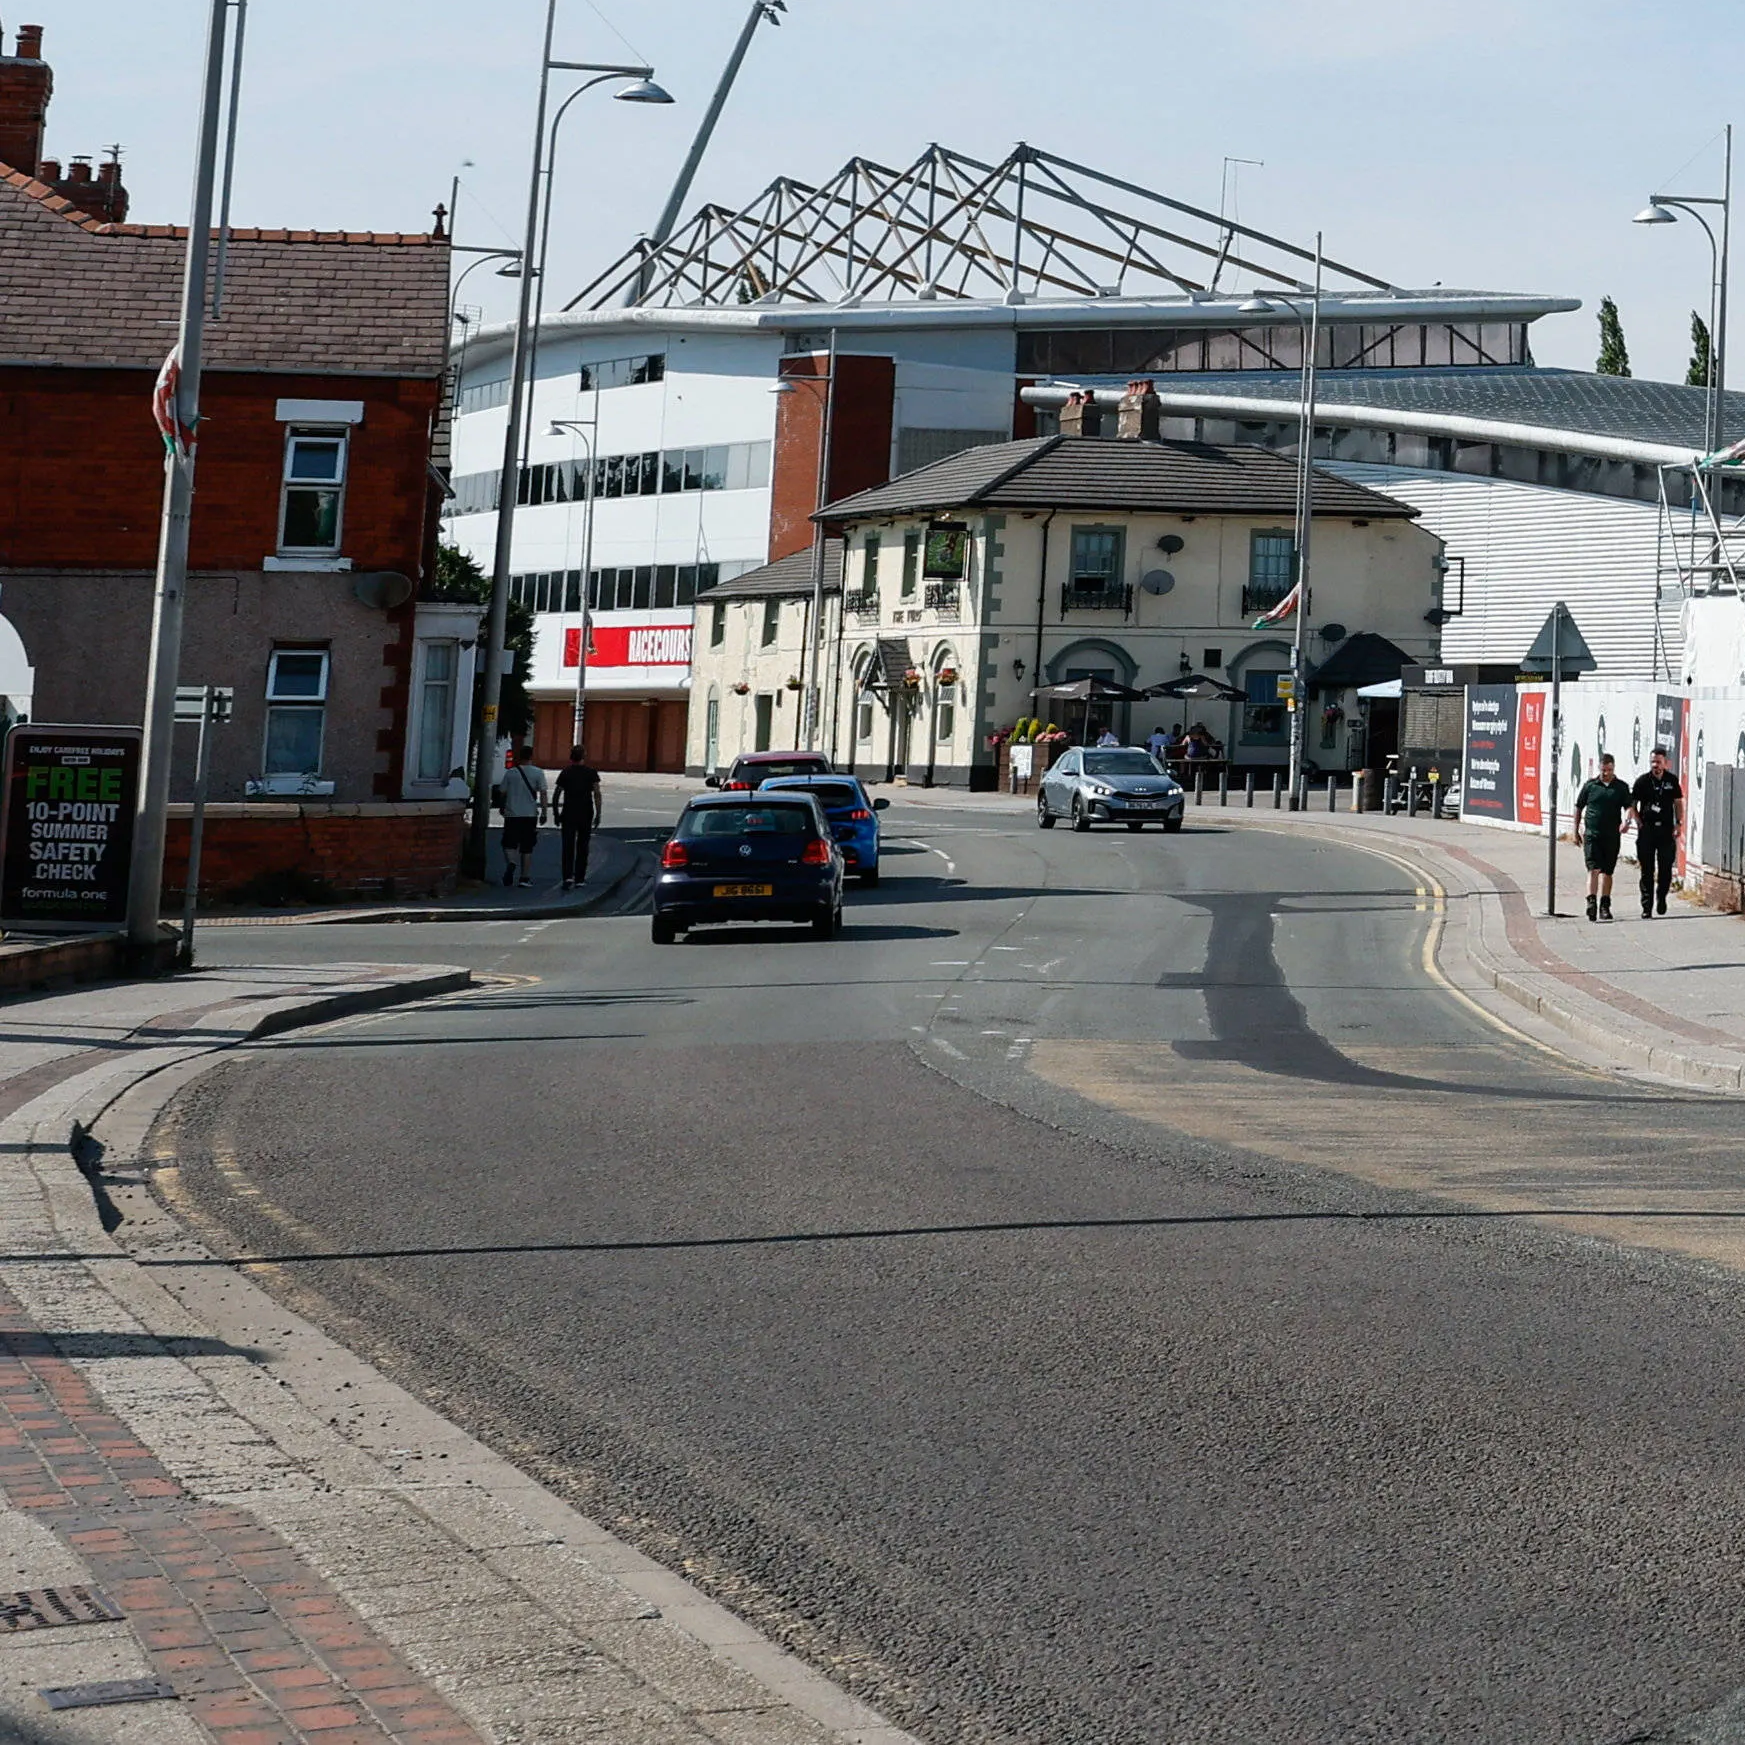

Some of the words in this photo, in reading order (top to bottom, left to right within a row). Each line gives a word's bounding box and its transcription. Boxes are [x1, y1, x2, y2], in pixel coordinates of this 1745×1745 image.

[26, 766, 123, 801] FREE
[25, 802, 120, 822] 10-POINT
[31, 823, 108, 840] SUMMER
[29, 841, 106, 862] SAFETY
[36, 863, 96, 880] CHECK
[22, 887, 77, 899] formula
[81, 890, 107, 900] one
